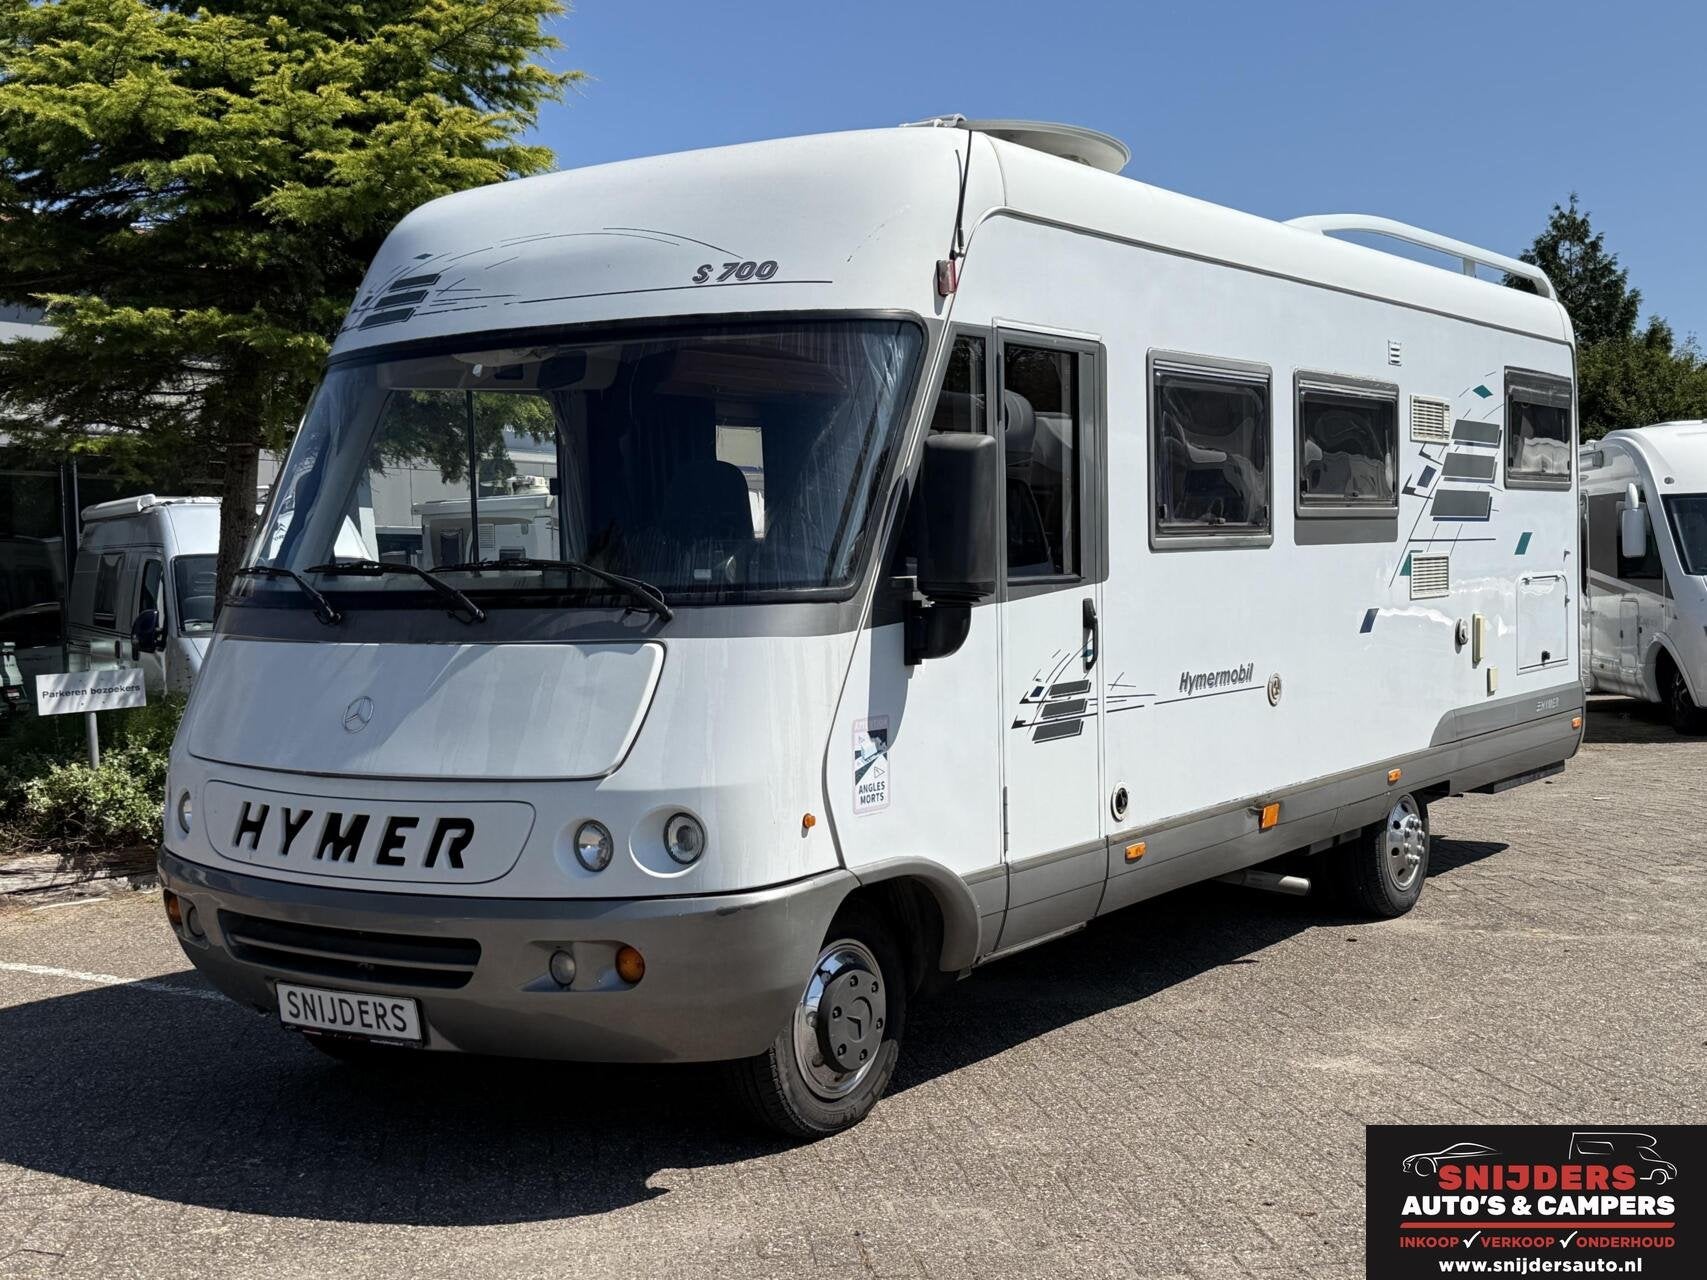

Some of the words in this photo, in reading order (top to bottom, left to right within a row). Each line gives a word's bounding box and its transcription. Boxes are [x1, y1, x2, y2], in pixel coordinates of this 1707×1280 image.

[692, 264, 714, 284] S
[715, 260, 779, 283] 700
[1179, 662, 1254, 696] Hymermobil
[42, 688, 88, 699] Parkeren
[90, 684, 141, 695] bezoekers
[859, 781, 886, 795] ANGLES
[860, 792, 885, 806] MORTS
[233, 801, 475, 869] HYMER
[287, 991, 407, 1032] SNIJDERS
